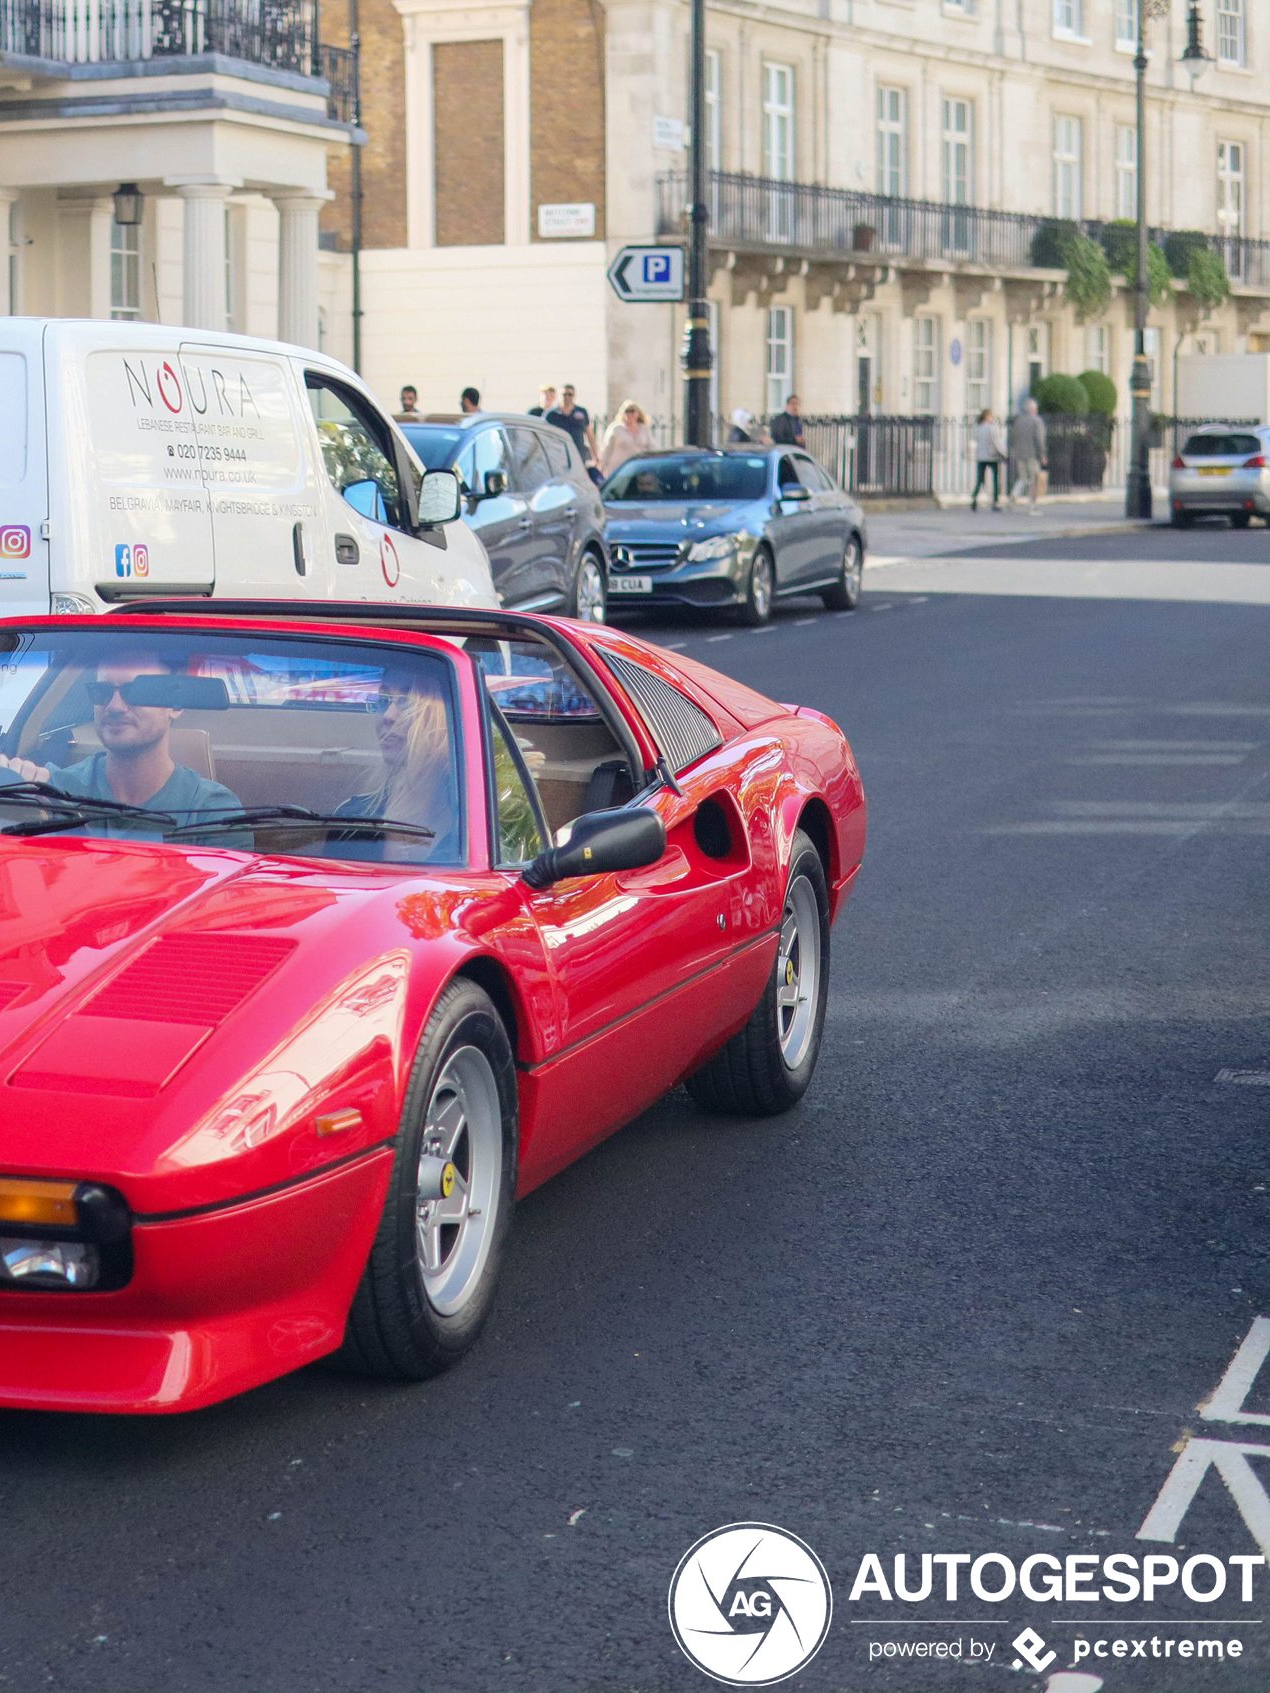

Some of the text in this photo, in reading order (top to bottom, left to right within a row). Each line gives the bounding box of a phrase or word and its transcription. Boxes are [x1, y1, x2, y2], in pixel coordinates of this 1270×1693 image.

[648, 257, 666, 281] P
[123, 357, 261, 419] NOURA
[136, 418, 265, 440] LEBANESE RESTAURANT BAR AND GRILL
[177, 444, 247, 462] 020 7235 9444
[163, 467, 257, 483] www.noura.co.uk
[109, 496, 162, 512] BELGRAVIA,
[165, 499, 204, 514] MAYFAIR,
[206, 500, 271, 515] KNIGHTSBRIDGE
[280, 504, 317, 517] KINGSTON
[621, 579, 643, 590] CUA
